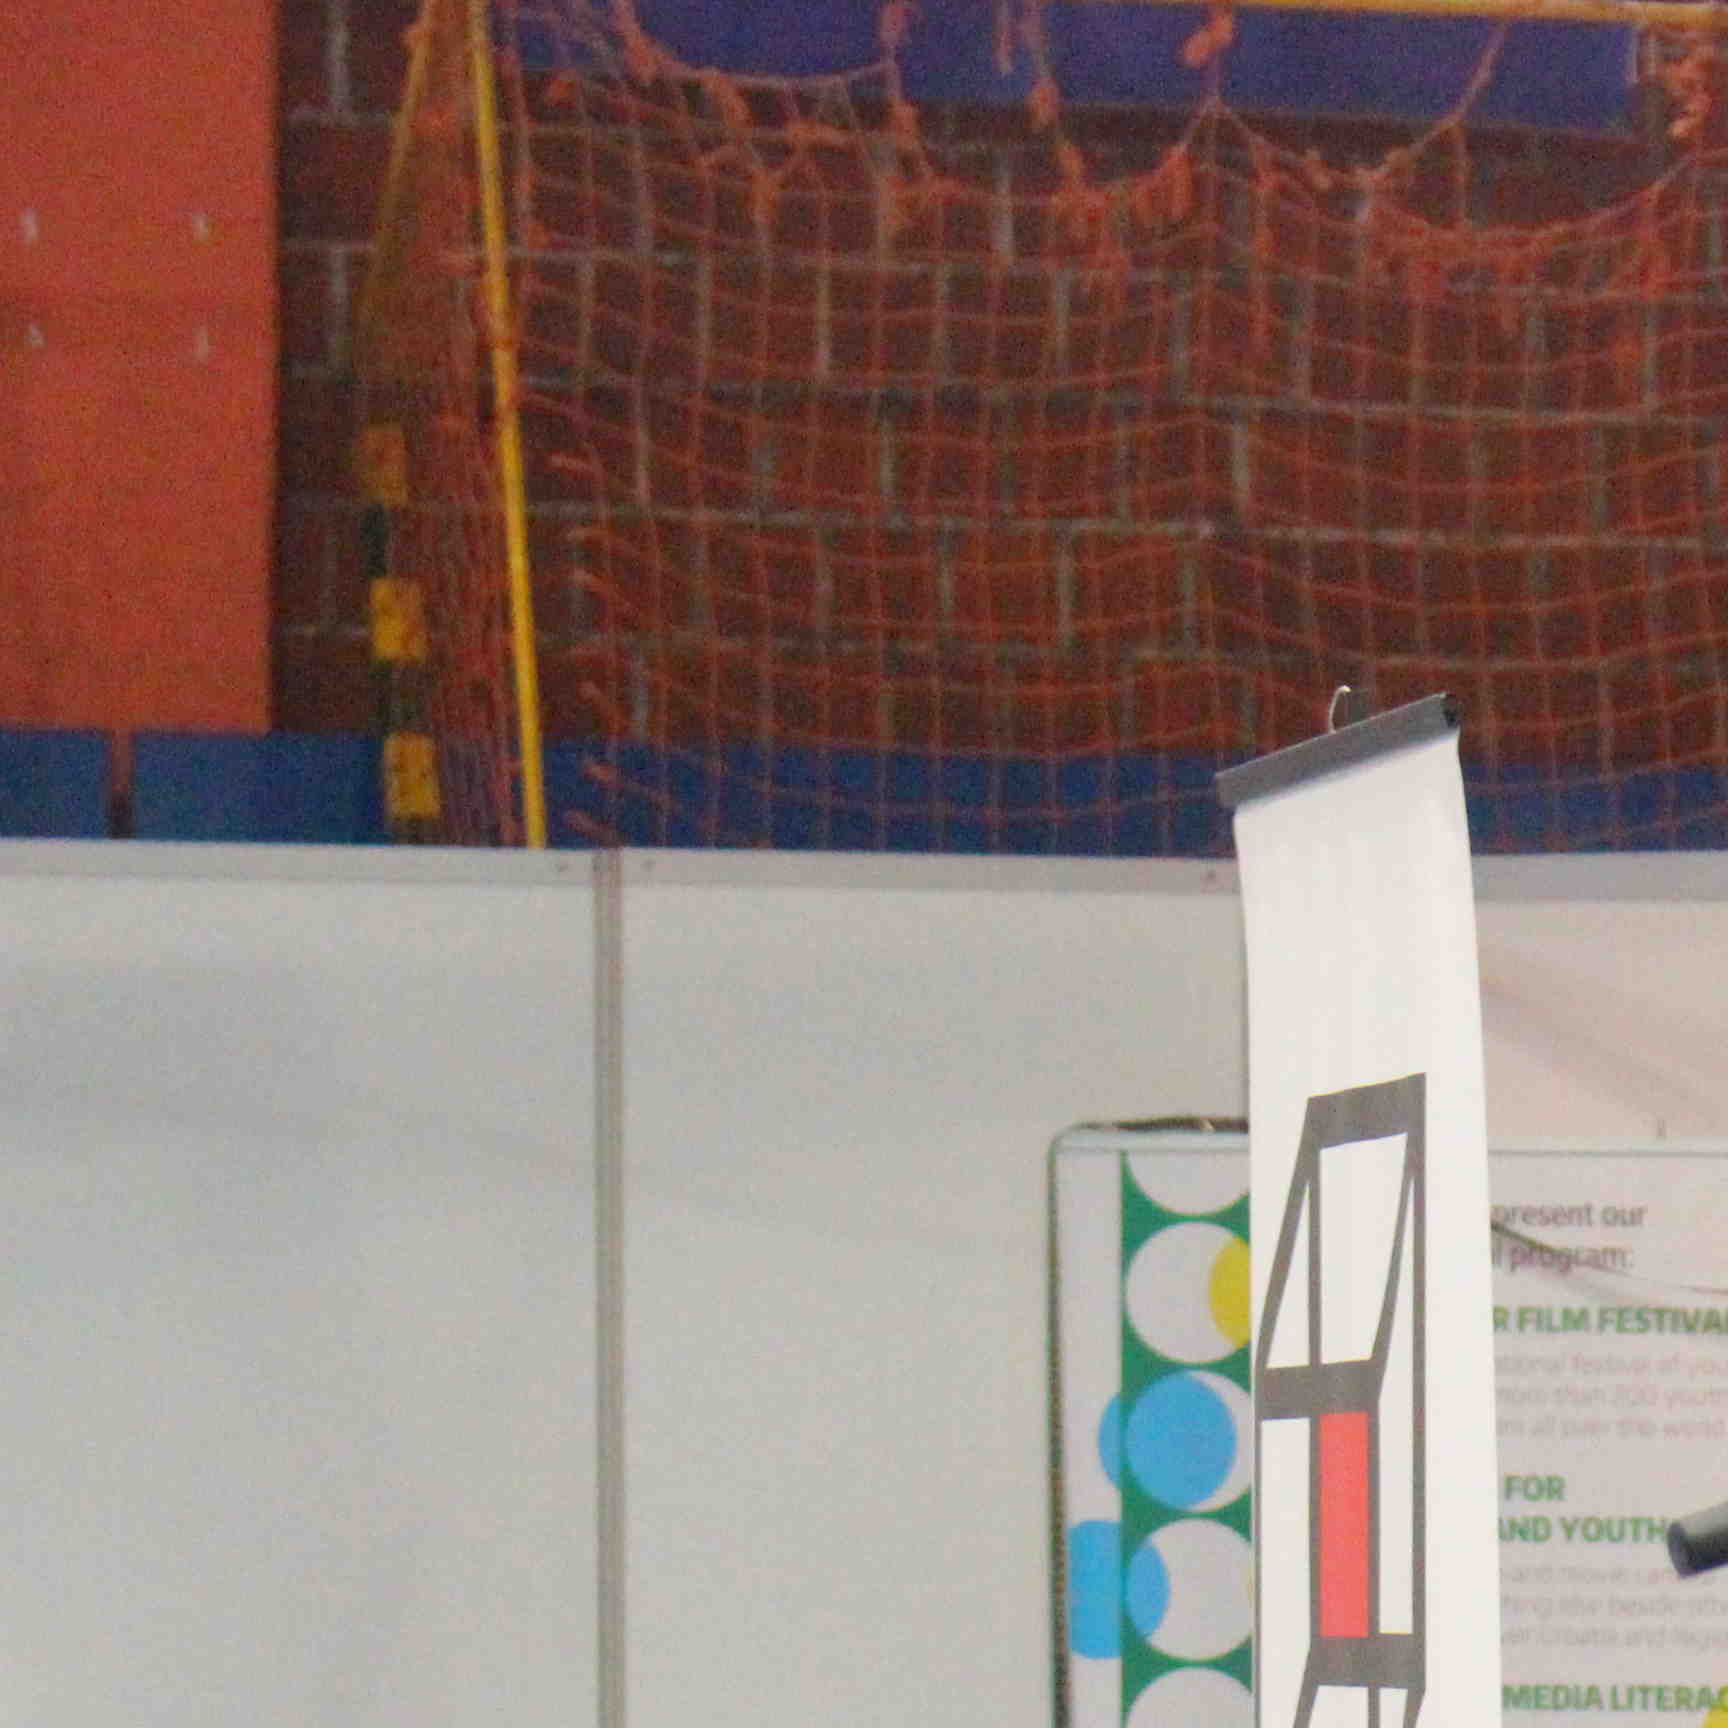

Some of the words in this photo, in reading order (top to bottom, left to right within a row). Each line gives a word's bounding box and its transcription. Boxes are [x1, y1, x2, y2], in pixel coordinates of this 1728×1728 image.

[1601, 1206, 1646, 1228] our
[1517, 1305, 1590, 1334] FILM
[1504, 1474, 1566, 1501] FOR
[1559, 1516, 1668, 1543] YOUTH
[1502, 1684, 1604, 1712] MEDIA
